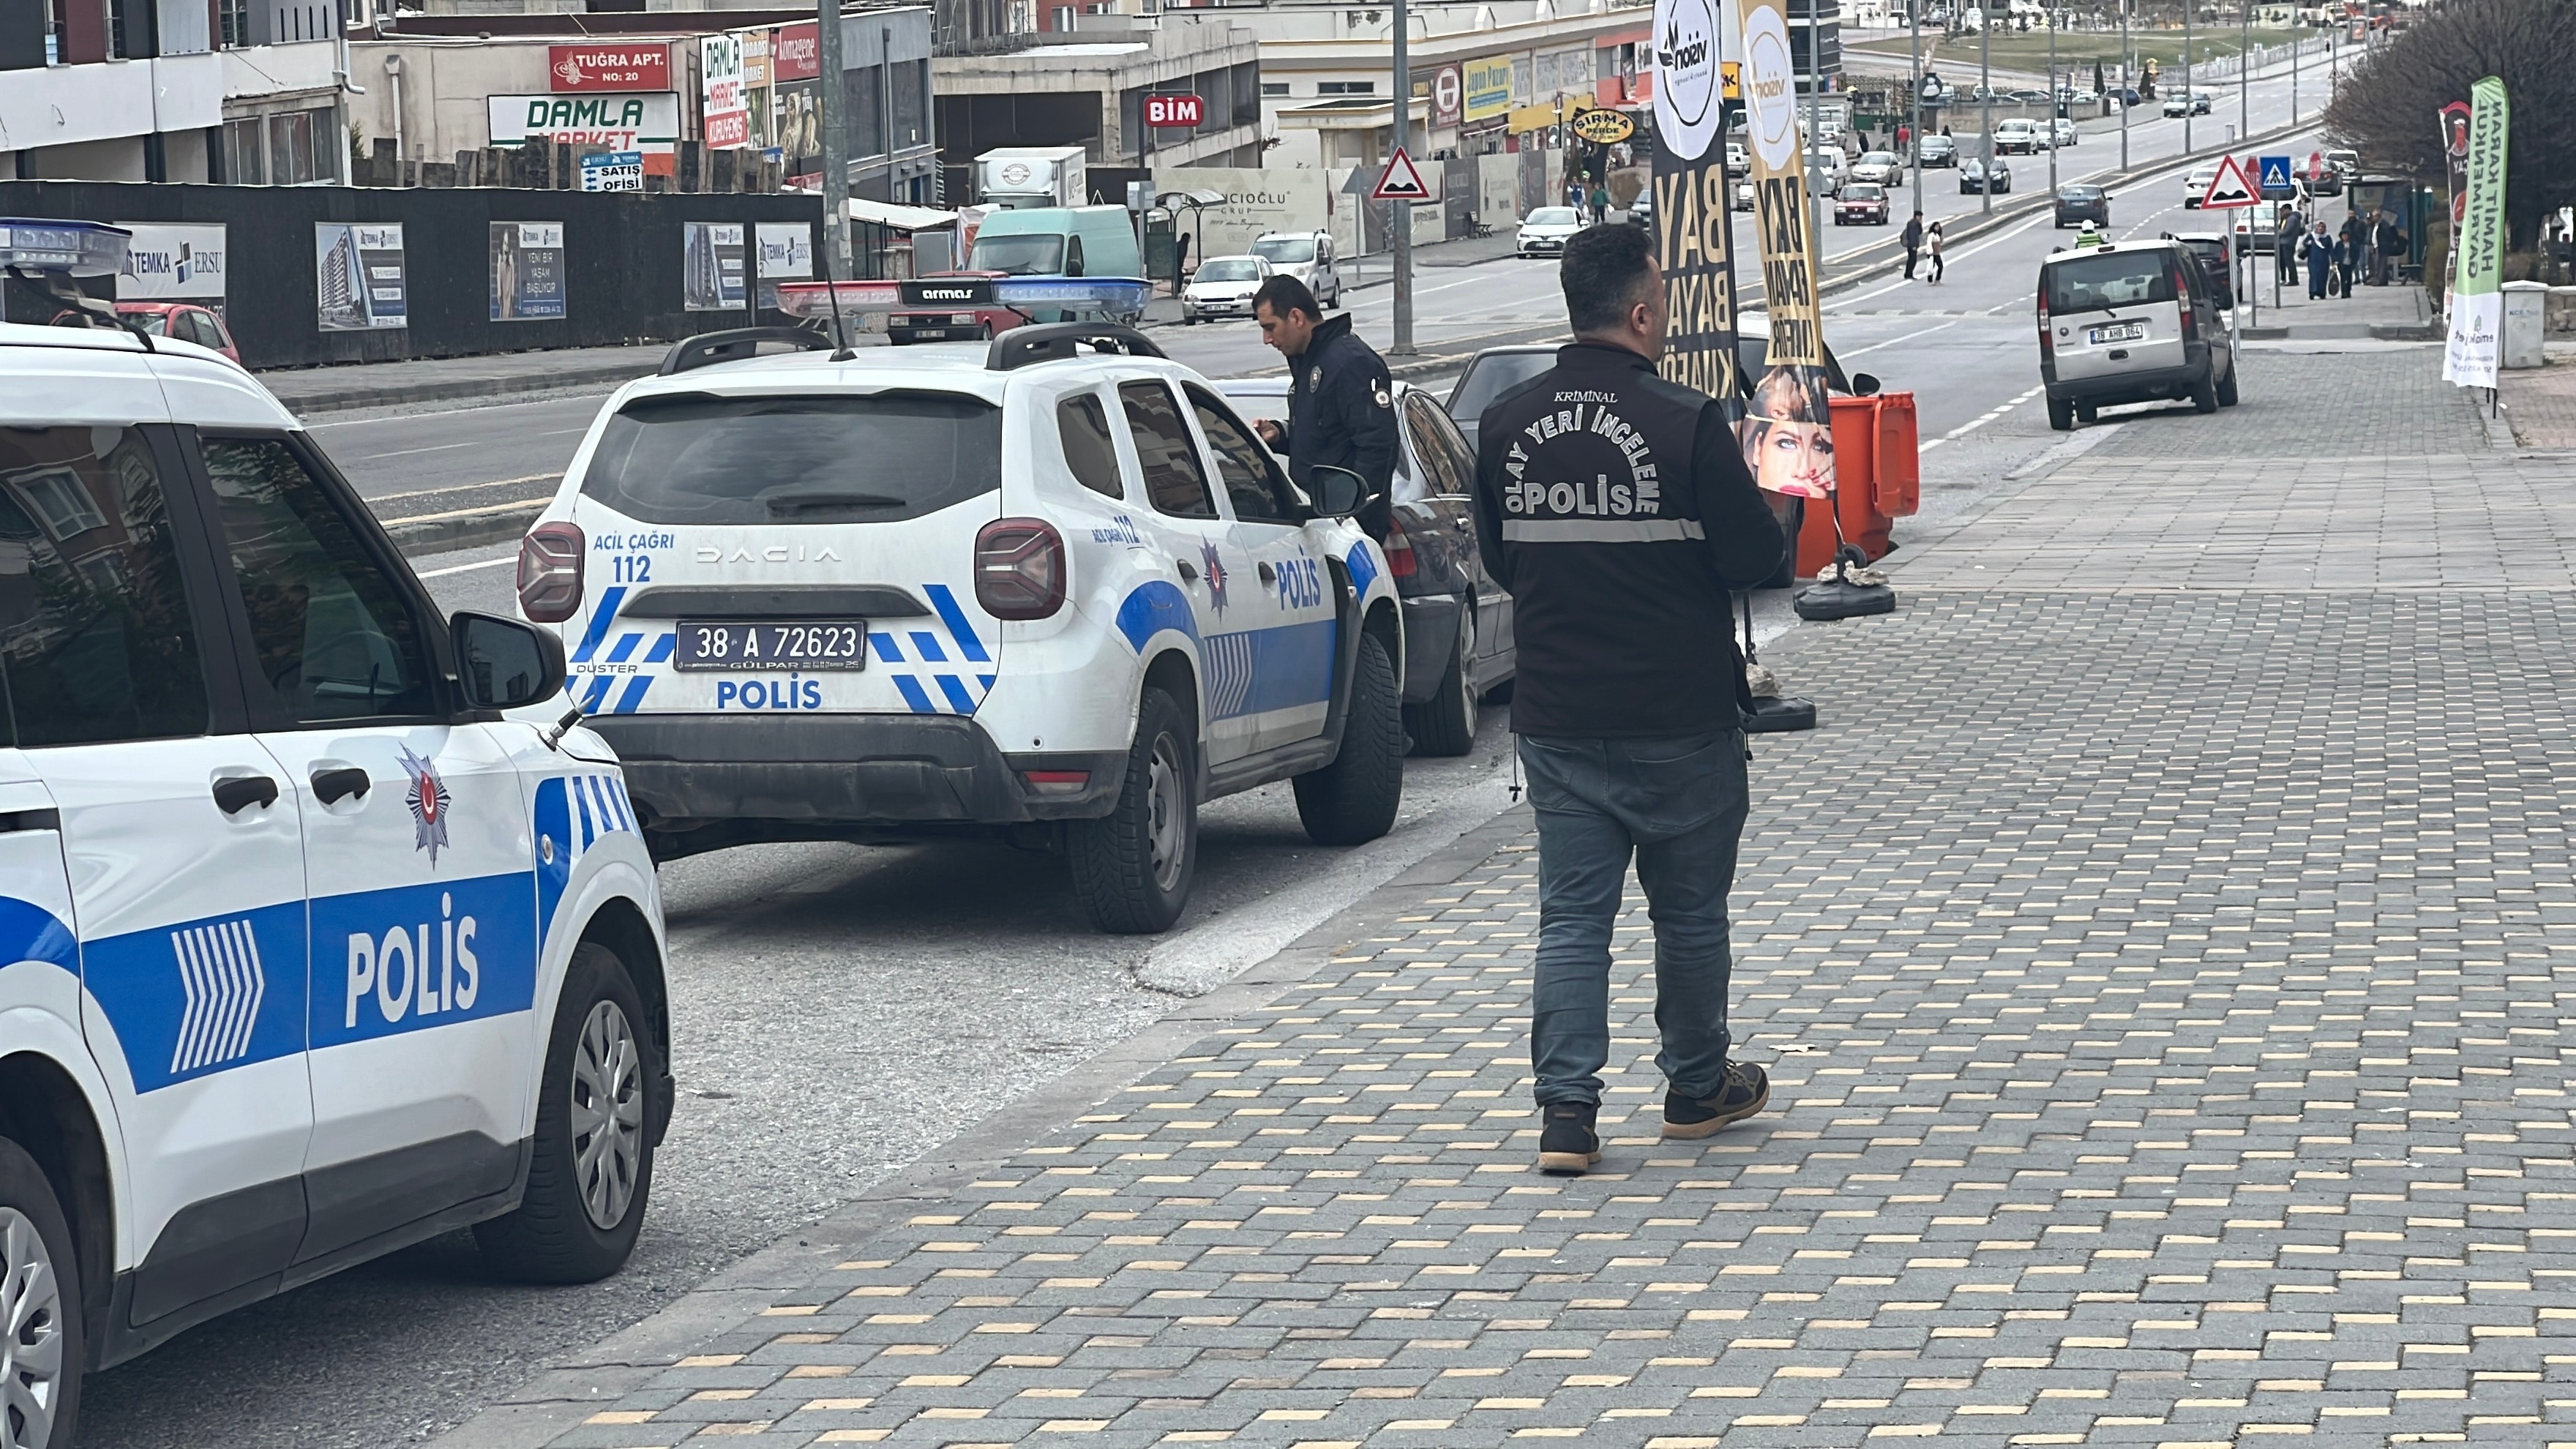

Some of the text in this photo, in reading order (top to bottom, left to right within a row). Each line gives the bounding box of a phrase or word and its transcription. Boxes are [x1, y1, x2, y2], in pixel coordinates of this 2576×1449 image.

[576, 52, 664, 67] TUĞRA APT.
[706, 40, 740, 79] DAMLA
[779, 34, 815, 69] komagene
[602, 72, 638, 81] NO: 20
[745, 64, 765, 82] ARKET
[710, 81, 738, 110] MARKET
[527, 100, 644, 128] DAMLA
[1150, 97, 1197, 122] BİM
[1576, 113, 1629, 130] SIRMA
[538, 131, 635, 151] ARKET
[602, 165, 640, 177] SATIŞ
[604, 178, 639, 190] OFİSİ
[135, 252, 222, 274] TEMKA ERSU
[922, 289, 973, 299] armas
[2108, 328, 2123, 338] AHB
[2125, 326, 2140, 337] 064
[1554, 390, 1618, 402] KRİMİNAL
[1505, 404, 1660, 514] OLAY YERİ İNCELEME
[1524, 474, 1633, 515] POLİS
[1114, 515, 1140, 544] 112
[594, 530, 675, 553] ACİL ÇAĞRI
[696, 546, 842, 563] DACIA
[613, 555, 651, 583] 112
[1276, 544, 1320, 611] POLİS
[696, 627, 856, 658] 38 A 72623
[577, 664, 637, 674] DUSTER
[730, 661, 799, 669] GÜLPAR
[718, 672, 821, 709] POLİS
[345, 891, 479, 1028] POLİS
